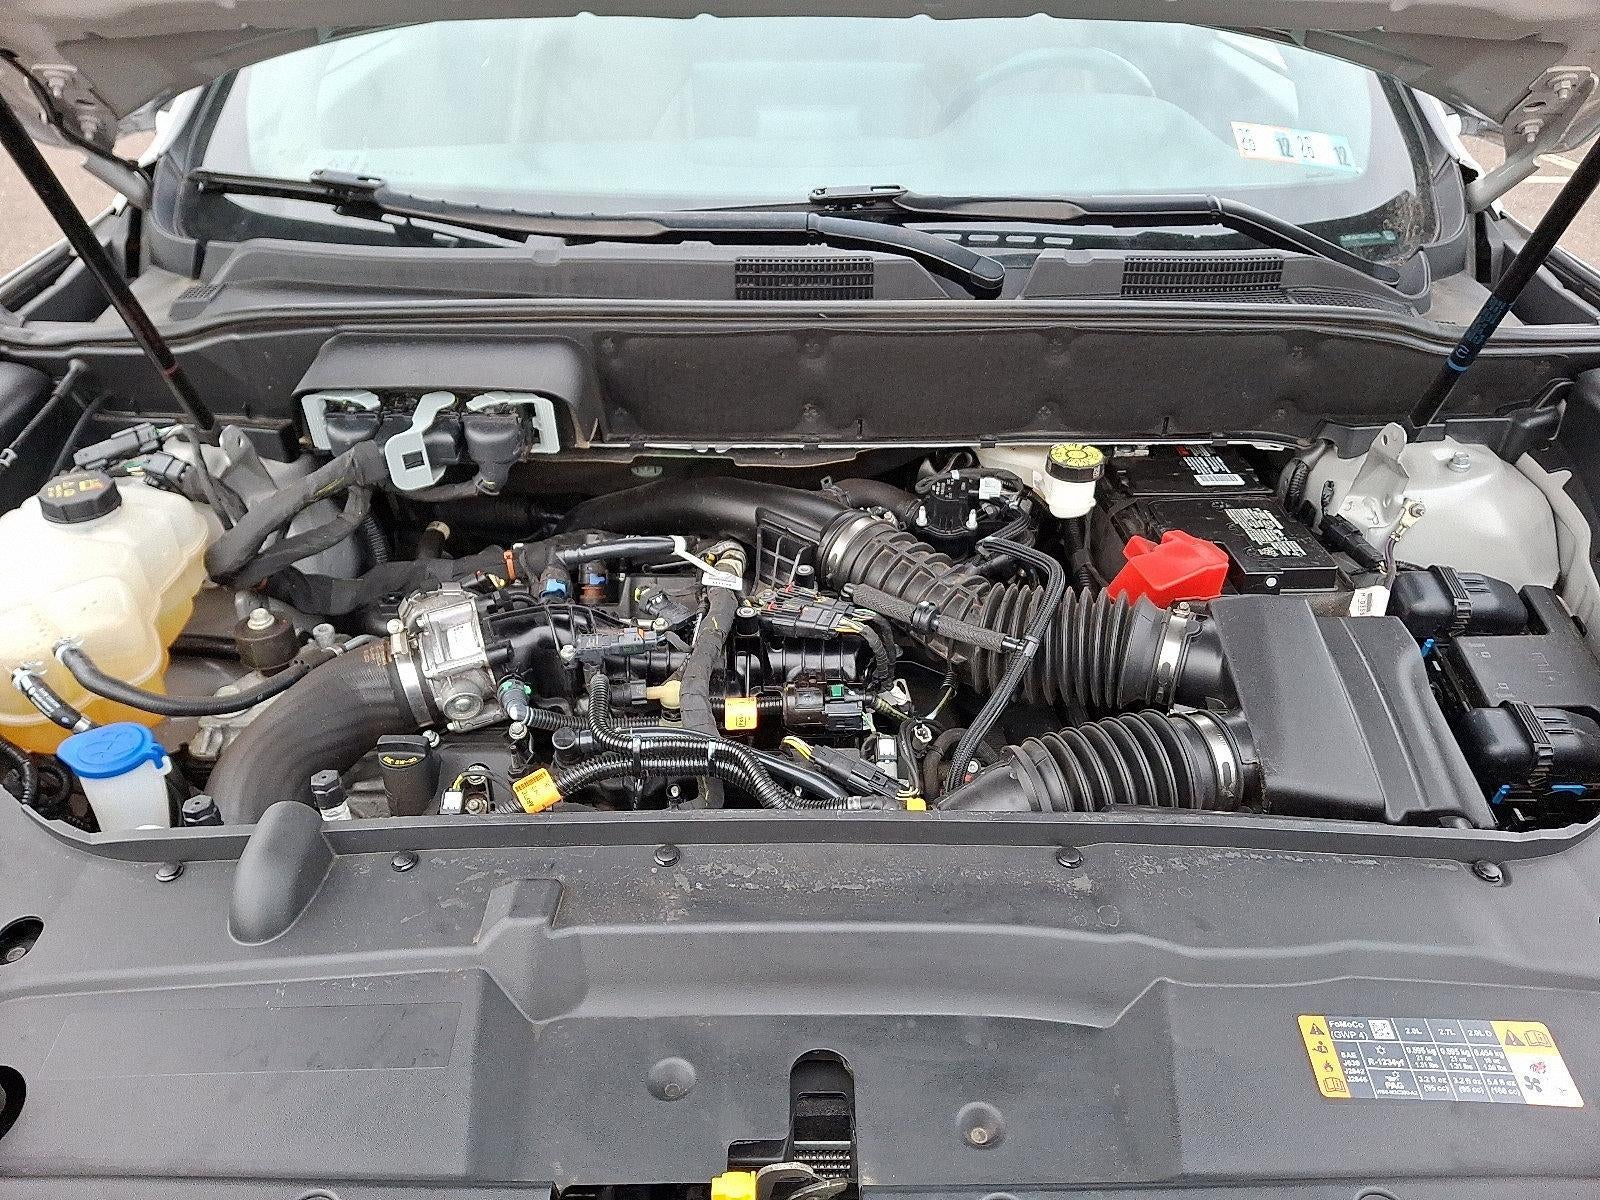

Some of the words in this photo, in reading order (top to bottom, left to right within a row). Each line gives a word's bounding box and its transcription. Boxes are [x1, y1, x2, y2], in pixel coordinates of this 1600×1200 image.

[1276, 137, 1294, 158] 12
[1333, 145, 1352, 167] 12
[1328, 1020, 1365, 1029] FoMoCo
[1330, 1030, 1357, 1040] (GWP
[1438, 1028, 1457, 1036] 2.7L
[1426, 1047, 1437, 1057] kg
[1460, 1048, 1471, 1058] kg
[1494, 1049, 1505, 1059] kg
[1367, 1057, 1405, 1067] R-1234yf
